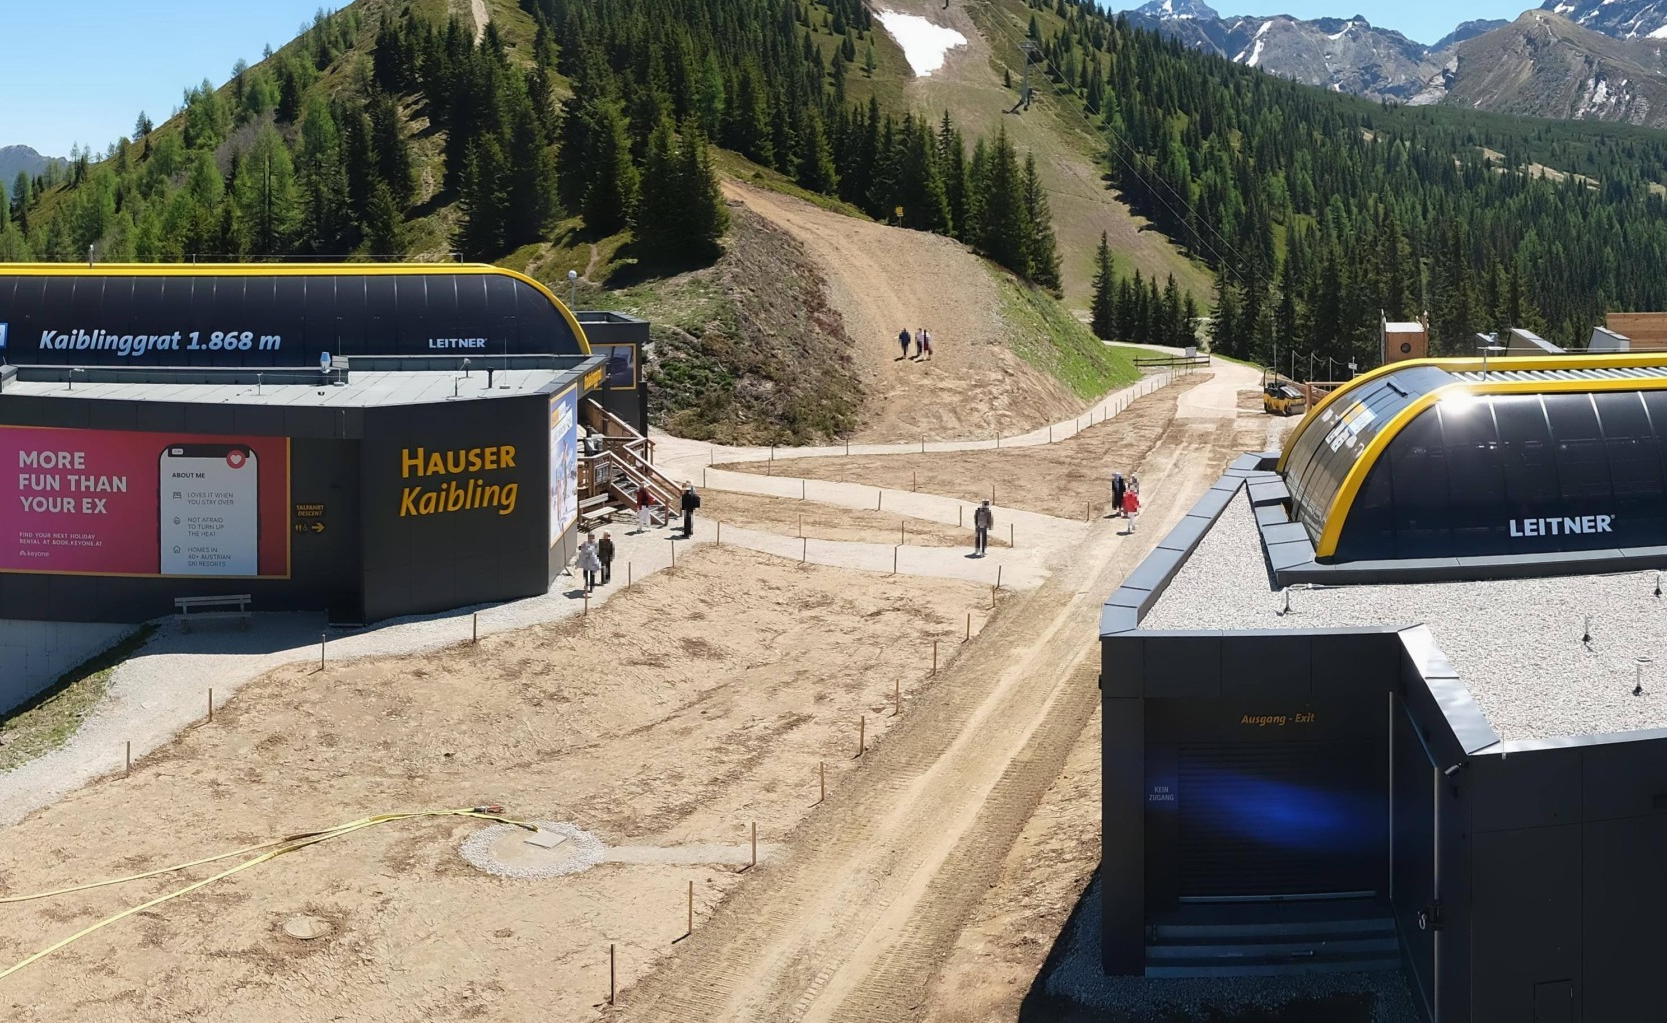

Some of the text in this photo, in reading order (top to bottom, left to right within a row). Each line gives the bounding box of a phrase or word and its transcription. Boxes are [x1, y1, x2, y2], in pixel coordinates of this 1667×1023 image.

[39, 329, 281, 356] Kaiblinggrat 1.868 m
[19, 450, 85, 469] MORE
[402, 445, 517, 478] HAUSER
[19, 474, 127, 492] FUN THAN
[20, 496, 107, 514] YOUR EX
[400, 479, 518, 517] Kaibling
[1240, 714, 1286, 726] Ausgang
[1295, 712, 1315, 723] Exit
